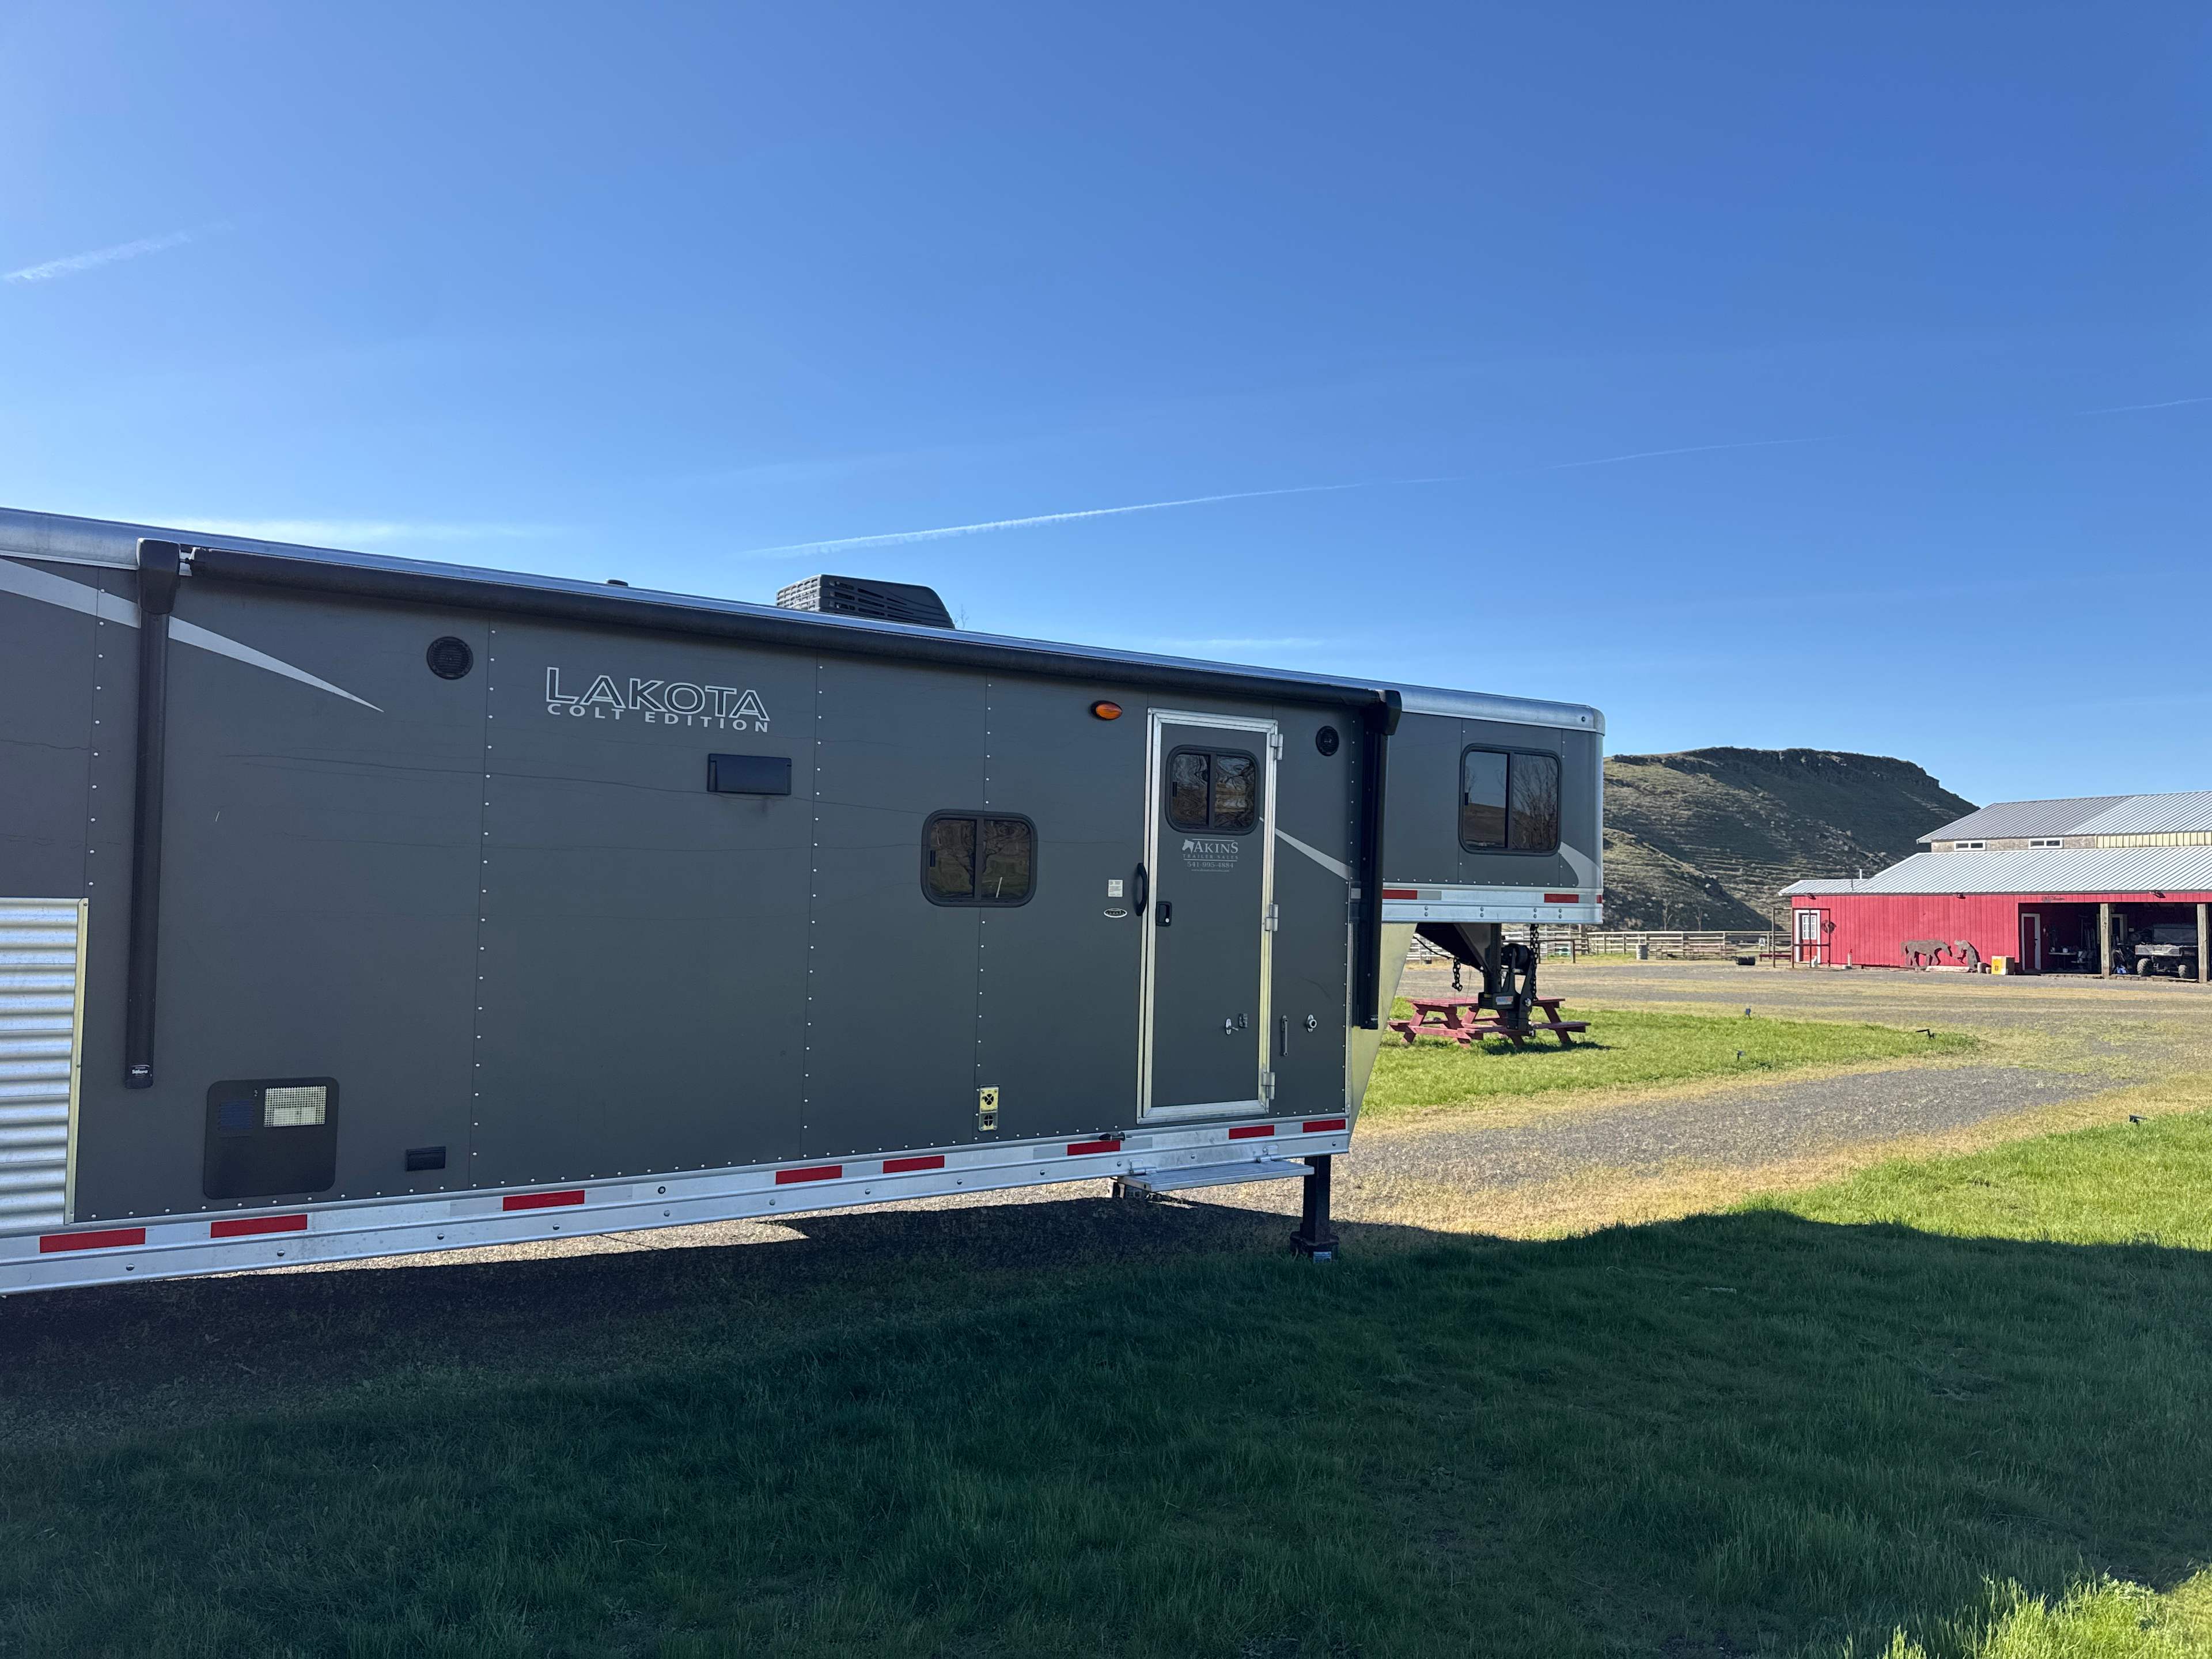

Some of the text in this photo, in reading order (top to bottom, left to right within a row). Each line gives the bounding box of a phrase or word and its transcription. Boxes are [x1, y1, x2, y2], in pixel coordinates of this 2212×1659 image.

[546, 666, 770, 721] LAKOTA
[547, 703, 768, 733] COLT EDITION
[1194, 840, 1238, 854] AKINS
